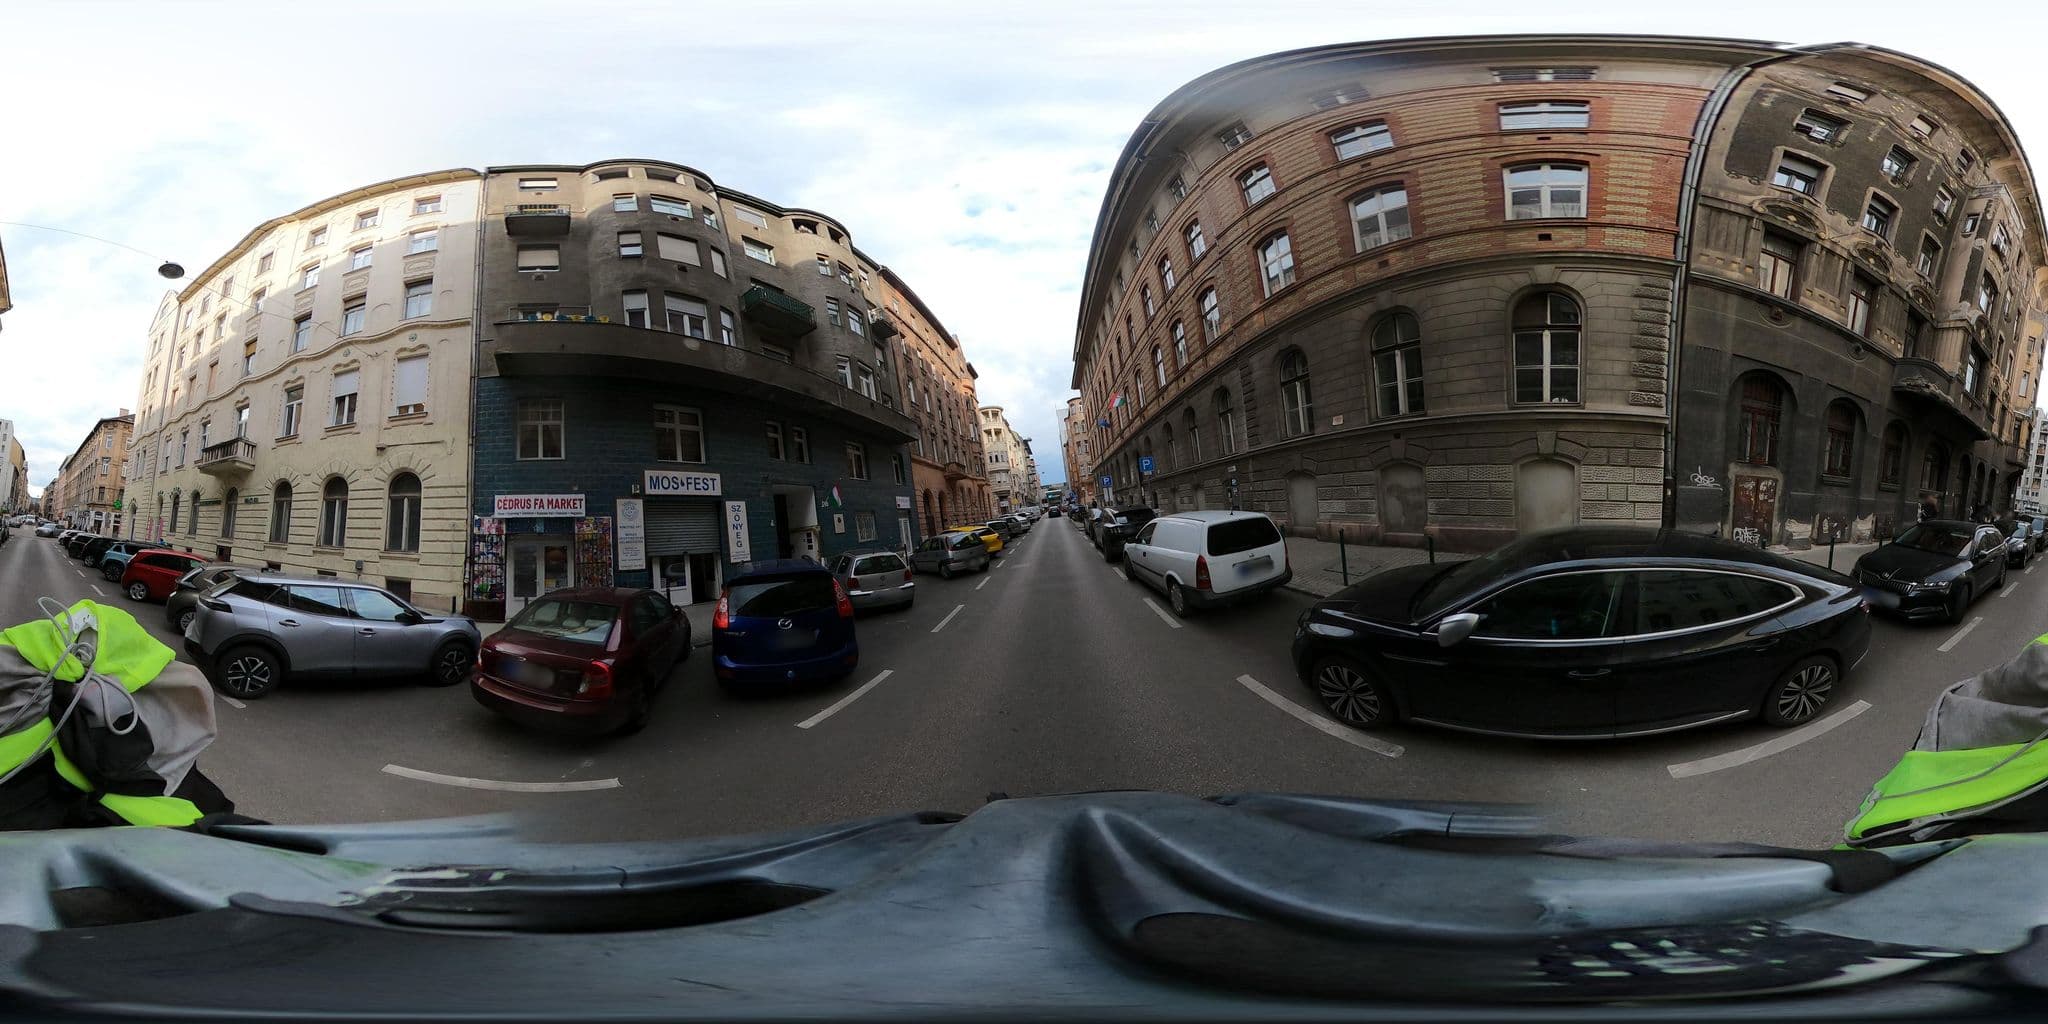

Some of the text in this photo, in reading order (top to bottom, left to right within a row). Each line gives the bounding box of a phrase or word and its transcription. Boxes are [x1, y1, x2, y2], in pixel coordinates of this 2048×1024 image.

[1142, 459, 1150, 469] P
[649, 475, 717, 491] MOS FEST
[497, 496, 584, 510] CÉDRUS FA MARKET
